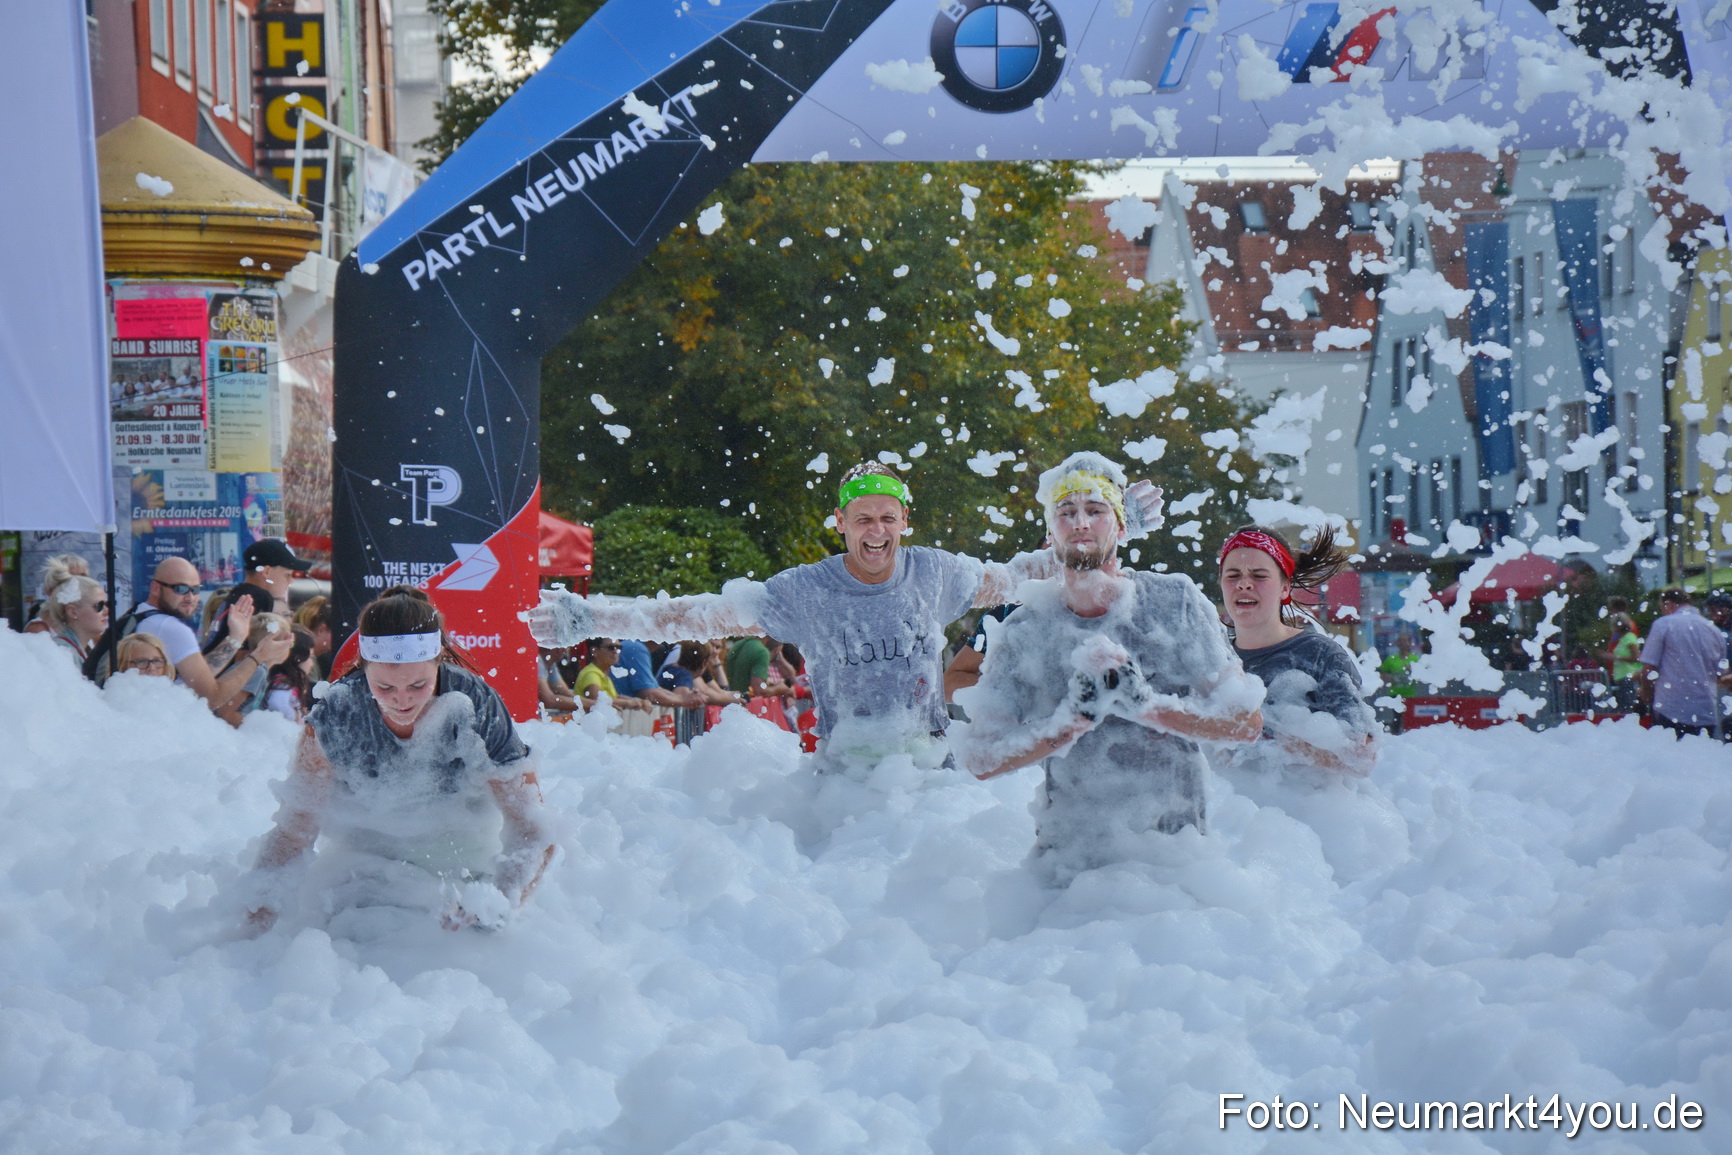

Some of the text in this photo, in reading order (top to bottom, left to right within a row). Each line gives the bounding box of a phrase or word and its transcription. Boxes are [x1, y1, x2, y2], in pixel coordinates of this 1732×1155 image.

[941, 0, 1053, 23] BW
[402, 85, 698, 291] PARTL NEUMARKT
[112, 339, 199, 355] BAND SUNRISE
[152, 404, 201, 417] 20 JAHRE
[115, 423, 165, 432] Gottesdienst
[172, 422, 201, 431] Konzert
[115, 434, 152, 446] 21.09.19
[160, 433, 184, 445] 18.30
[186, 433, 201, 444] Uhr
[166, 446, 202, 455] Neumarkt
[132, 506, 242, 519] Erntedankfest 2019
[382, 561, 446, 576] THE NEXT
[363, 575, 430, 589] 100 YEARS
